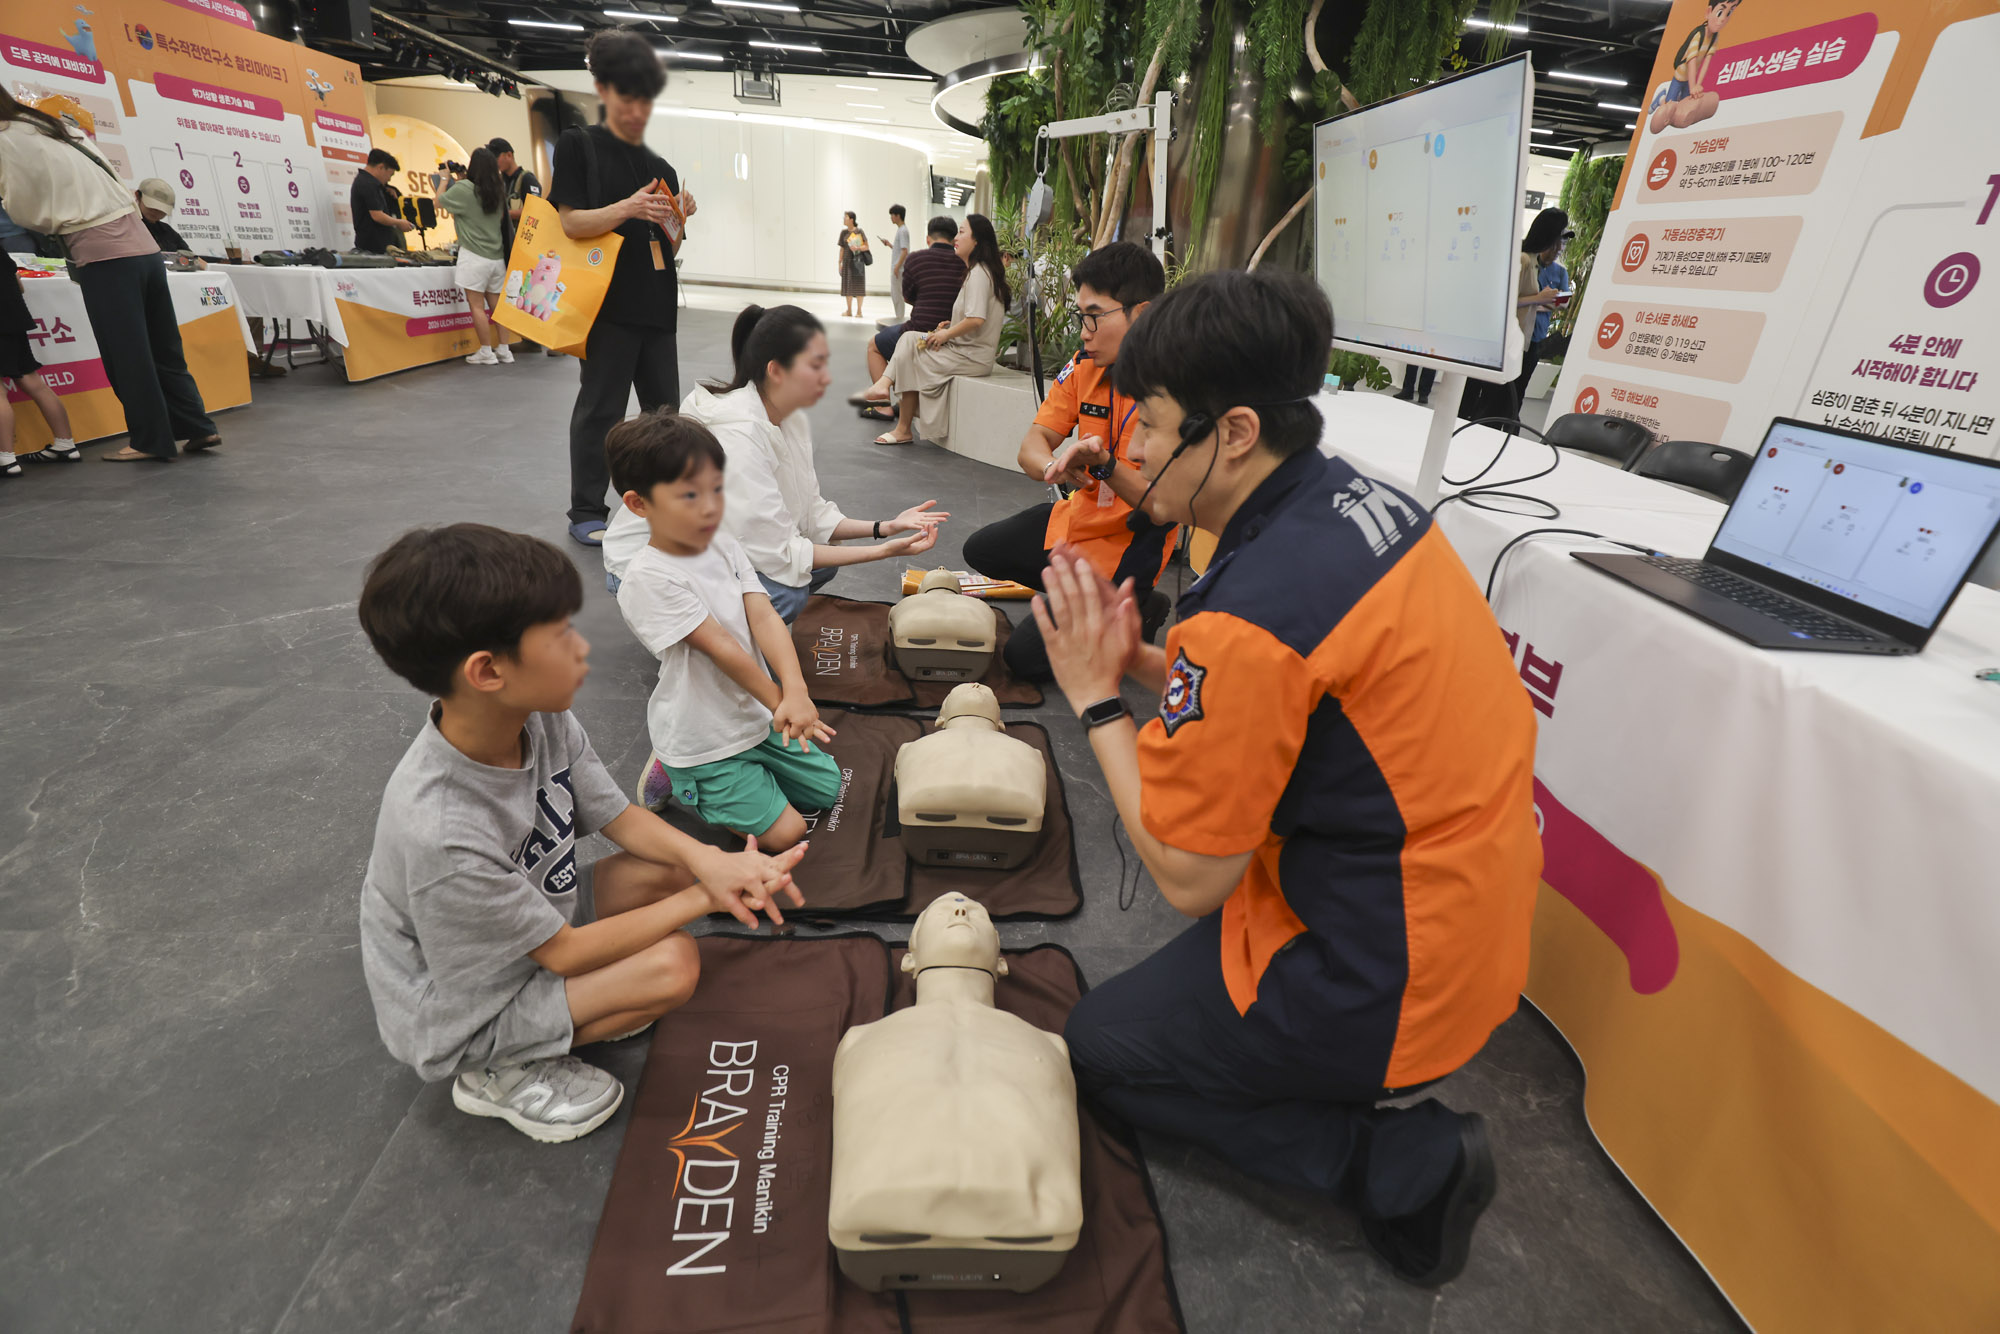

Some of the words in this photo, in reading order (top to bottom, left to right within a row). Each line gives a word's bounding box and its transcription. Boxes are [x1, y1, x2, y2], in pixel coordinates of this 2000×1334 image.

[10, 46, 31, 61] 드론
[32, 51, 60, 68] 공격에
[62, 58, 96, 76] 대비하기
[156, 33, 234, 68] 특수작전연구소
[235, 56, 282, 81] 찰리마이크
[1716, 47, 1802, 85] 심폐소생술
[1804, 36, 1847, 67] 실습
[251, 130, 258, 140] 수
[1690, 136, 1730, 154] 가슴압박
[175, 142, 184, 160] 1
[233, 151, 243, 168] 2
[284, 158, 293, 174] 3
[1683, 165, 1698, 176] 가슴
[1698, 160, 1736, 175] 한가운데를
[1738, 158, 1760, 170] 1분에
[1762, 152, 1816, 168] 100~120번
[1687, 178, 1716, 188] 5~6cm
[1717, 174, 1742, 186] 깊이로
[1742, 171, 1776, 184] 누릅니다
[1976, 174, 2000, 225] 1
[1662, 228, 1726, 242] 자동심장충격기
[1656, 252, 1676, 261] 기계가
[1676, 251, 1704, 262] 음성으로
[1704, 252, 1728, 262] 안내해
[1728, 252, 1745, 263] 주기
[1745, 252, 1772, 264] 때문에
[1652, 264, 1671, 274] 누구나
[1672, 265, 1679, 275] 쓸
[1680, 266, 1687, 274] 수
[1688, 265, 1718, 276] 있습니다
[413, 288, 464, 308] 특수작전연구소
[455, 316, 473, 325] FREEDO
[1636, 311, 1645, 323] 이
[1645, 312, 1671, 326] 순서로
[1672, 314, 1698, 328] 하세요
[28, 316, 76, 347] 구소
[1637, 333, 1664, 346] 반응확인
[1675, 337, 1690, 348] 119
[1690, 339, 1706, 350] 신고
[1633, 346, 1659, 358] 호흡확인
[1669, 350, 1698, 364] 가슴압박
[1888, 334, 1922, 355] 4분
[1922, 336, 1963, 359] 안에
[40, 371, 74, 388] IELD
[1852, 359, 1918, 384] 시작해야
[1918, 366, 1978, 392] 합니다
[1610, 388, 1627, 402] 직접
[1626, 391, 1659, 408] 해보세요
[1636, 414, 1660, 430] 압박하는
[1811, 390, 1852, 410] 심장이
[1851, 396, 1880, 415] 멈춘
[1881, 402, 1898, 418] 뒤
[1898, 404, 1942, 426] 4분이
[1941, 411, 1996, 435] 지나면
[1838, 416, 1880, 438] 손상이
[1880, 424, 1957, 450] 시작됩니다
[1333, 478, 1370, 518] 소방
[826, 803, 844, 832] Manikin
[550, 862, 576, 890] EST
[770, 1064, 790, 1097] CPR
[757, 1099, 786, 1160] Training
[666, 1040, 758, 1276] BRAYDEN
[752, 1163, 778, 1234] Manikin
